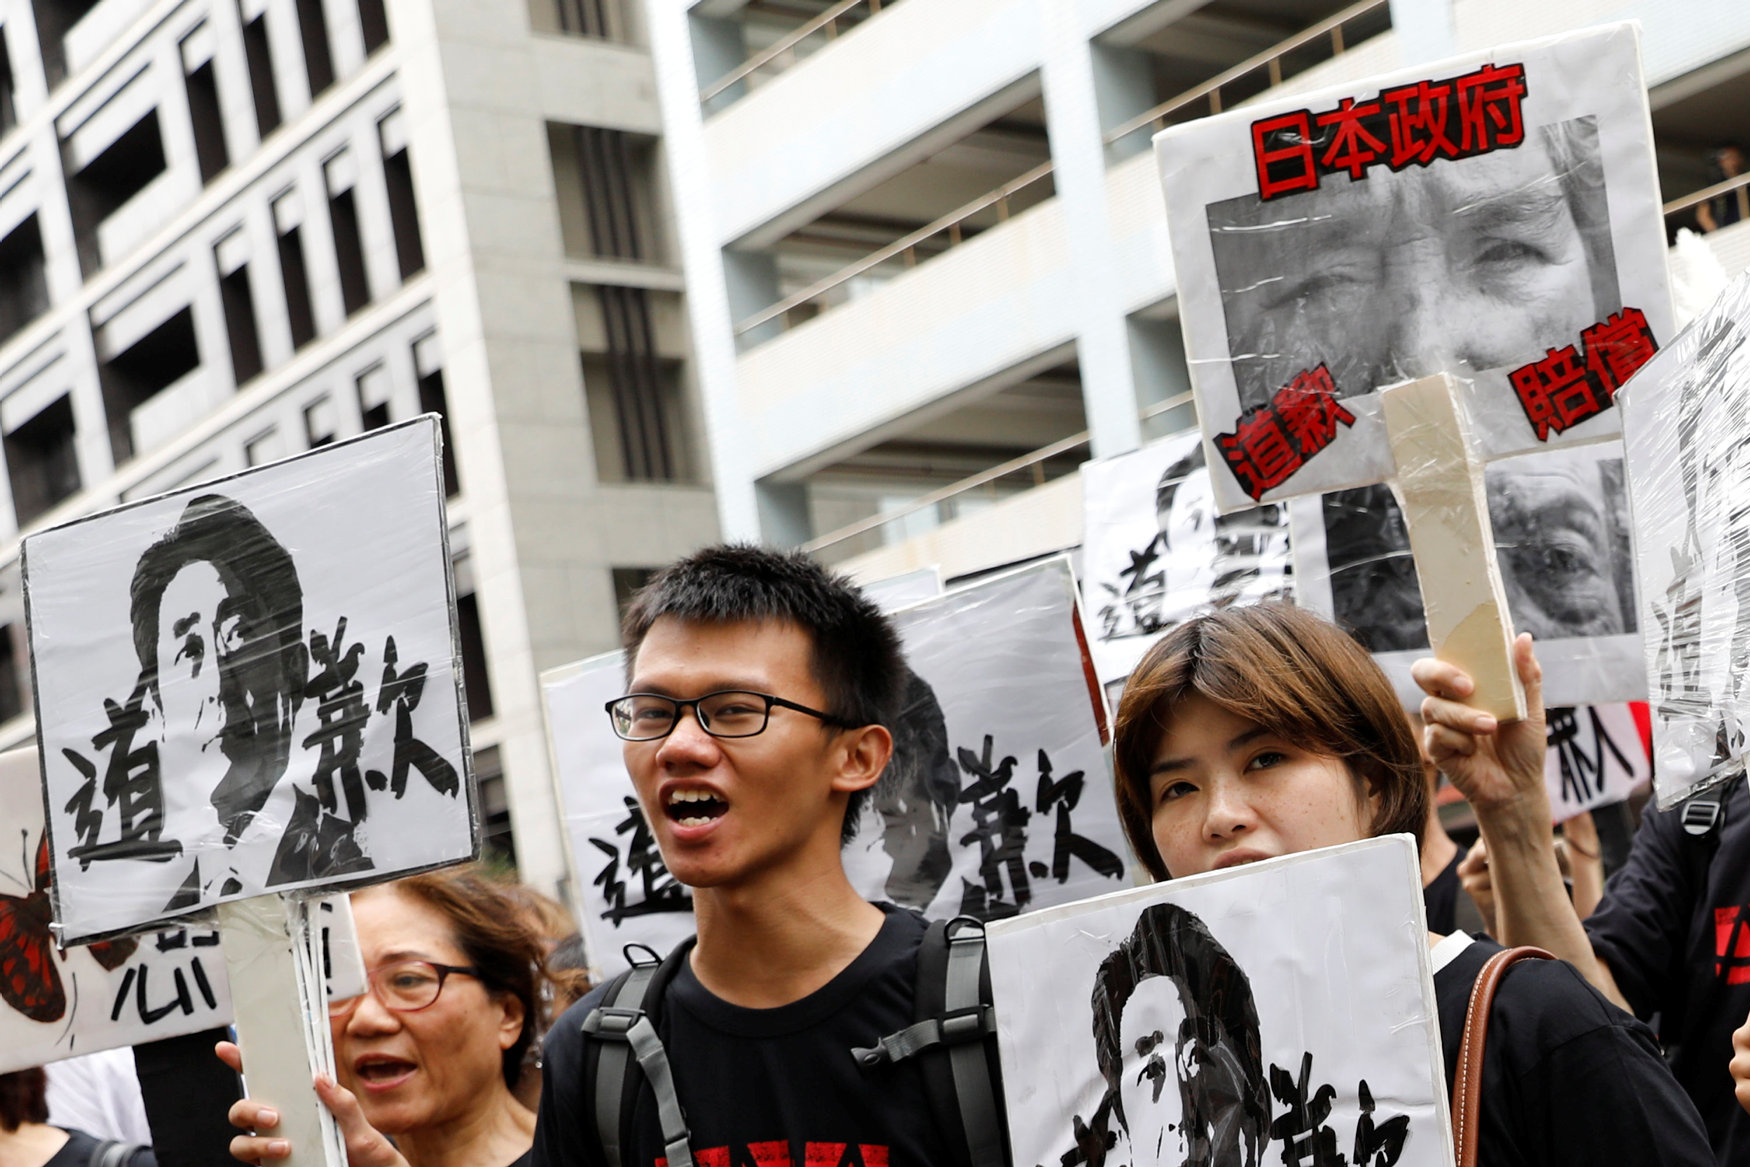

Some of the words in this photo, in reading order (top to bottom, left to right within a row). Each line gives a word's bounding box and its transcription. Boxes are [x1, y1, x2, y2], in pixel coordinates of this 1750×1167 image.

[1252, 64, 1526, 199] 日本政府
[1221, 365, 1355, 500] 道歉
[63, 616, 460, 871] 道歉
